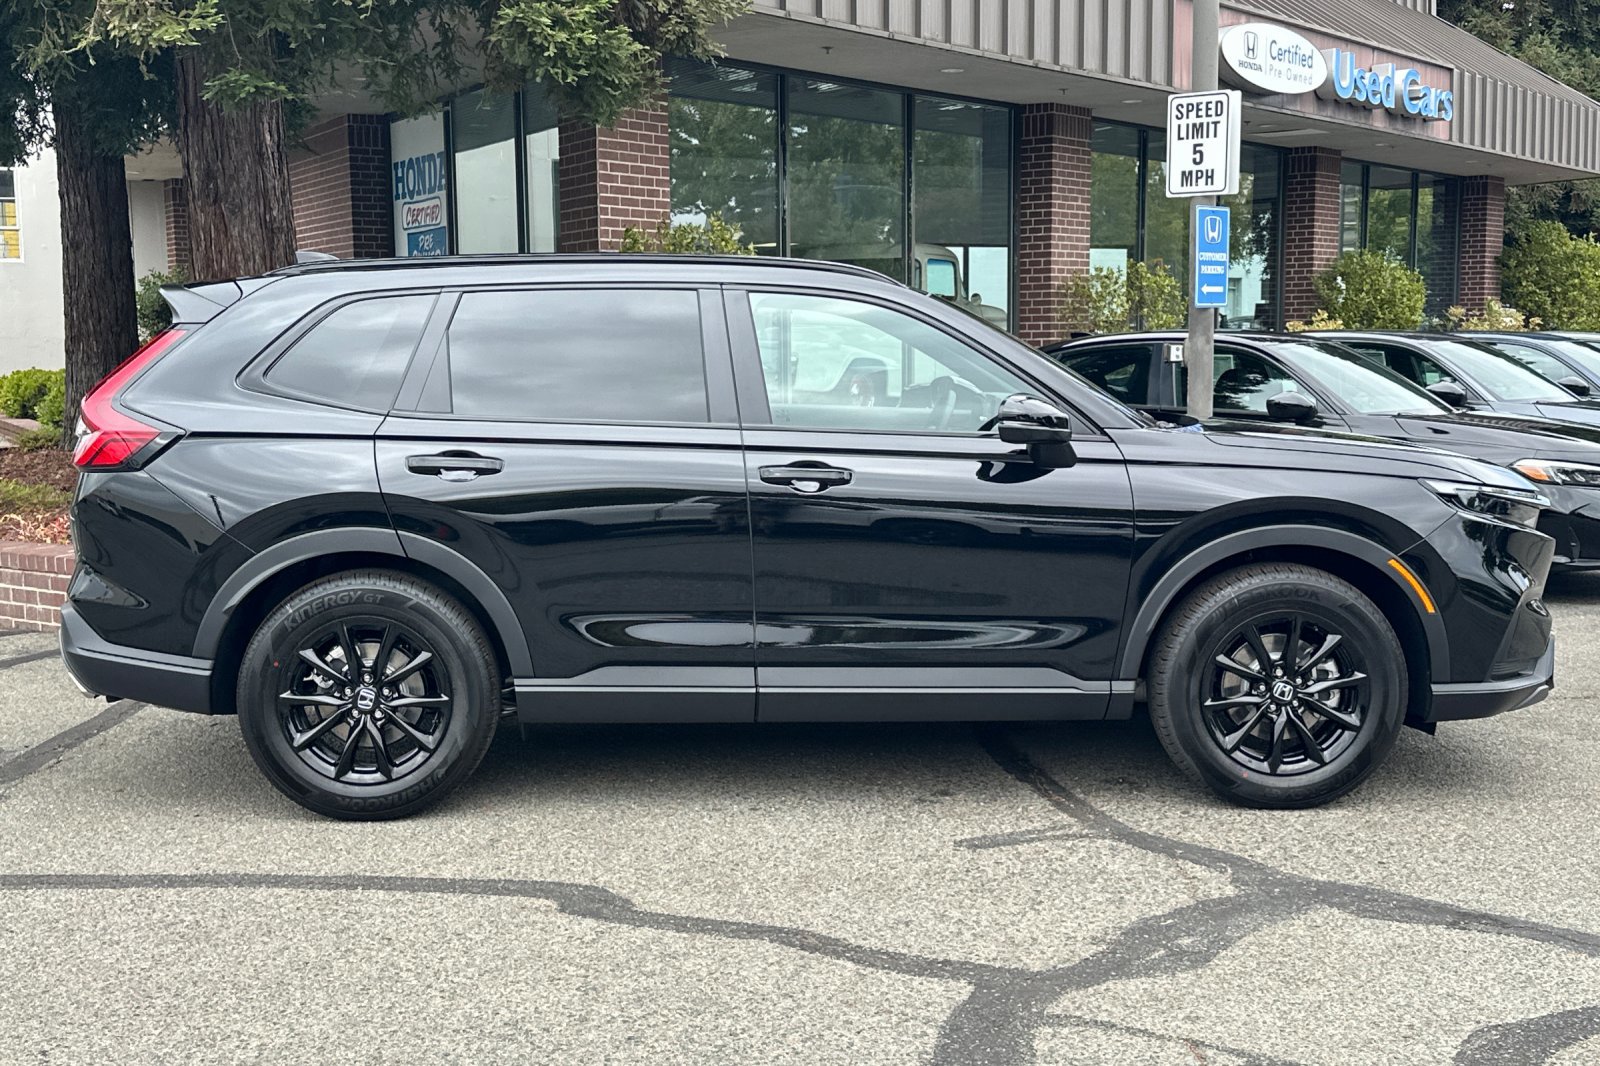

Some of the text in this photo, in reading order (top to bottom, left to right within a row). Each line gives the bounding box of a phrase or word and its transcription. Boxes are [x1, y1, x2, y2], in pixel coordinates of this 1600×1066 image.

[1269, 39, 1314, 69] Certified
[1238, 60, 1263, 72] HONDA
[1333, 47, 1453, 121] Used Cars
[1175, 100, 1224, 120] SPEED
[1177, 121, 1220, 141] LIMIT
[1192, 143, 1204, 166] 5
[393, 151, 446, 201] HONDA
[1180, 169, 1215, 188] MPH
[405, 204, 440, 226] CERTIFIED
[1199, 252, 1227, 262] CUSTOMER
[363, 593, 385, 604] GT
